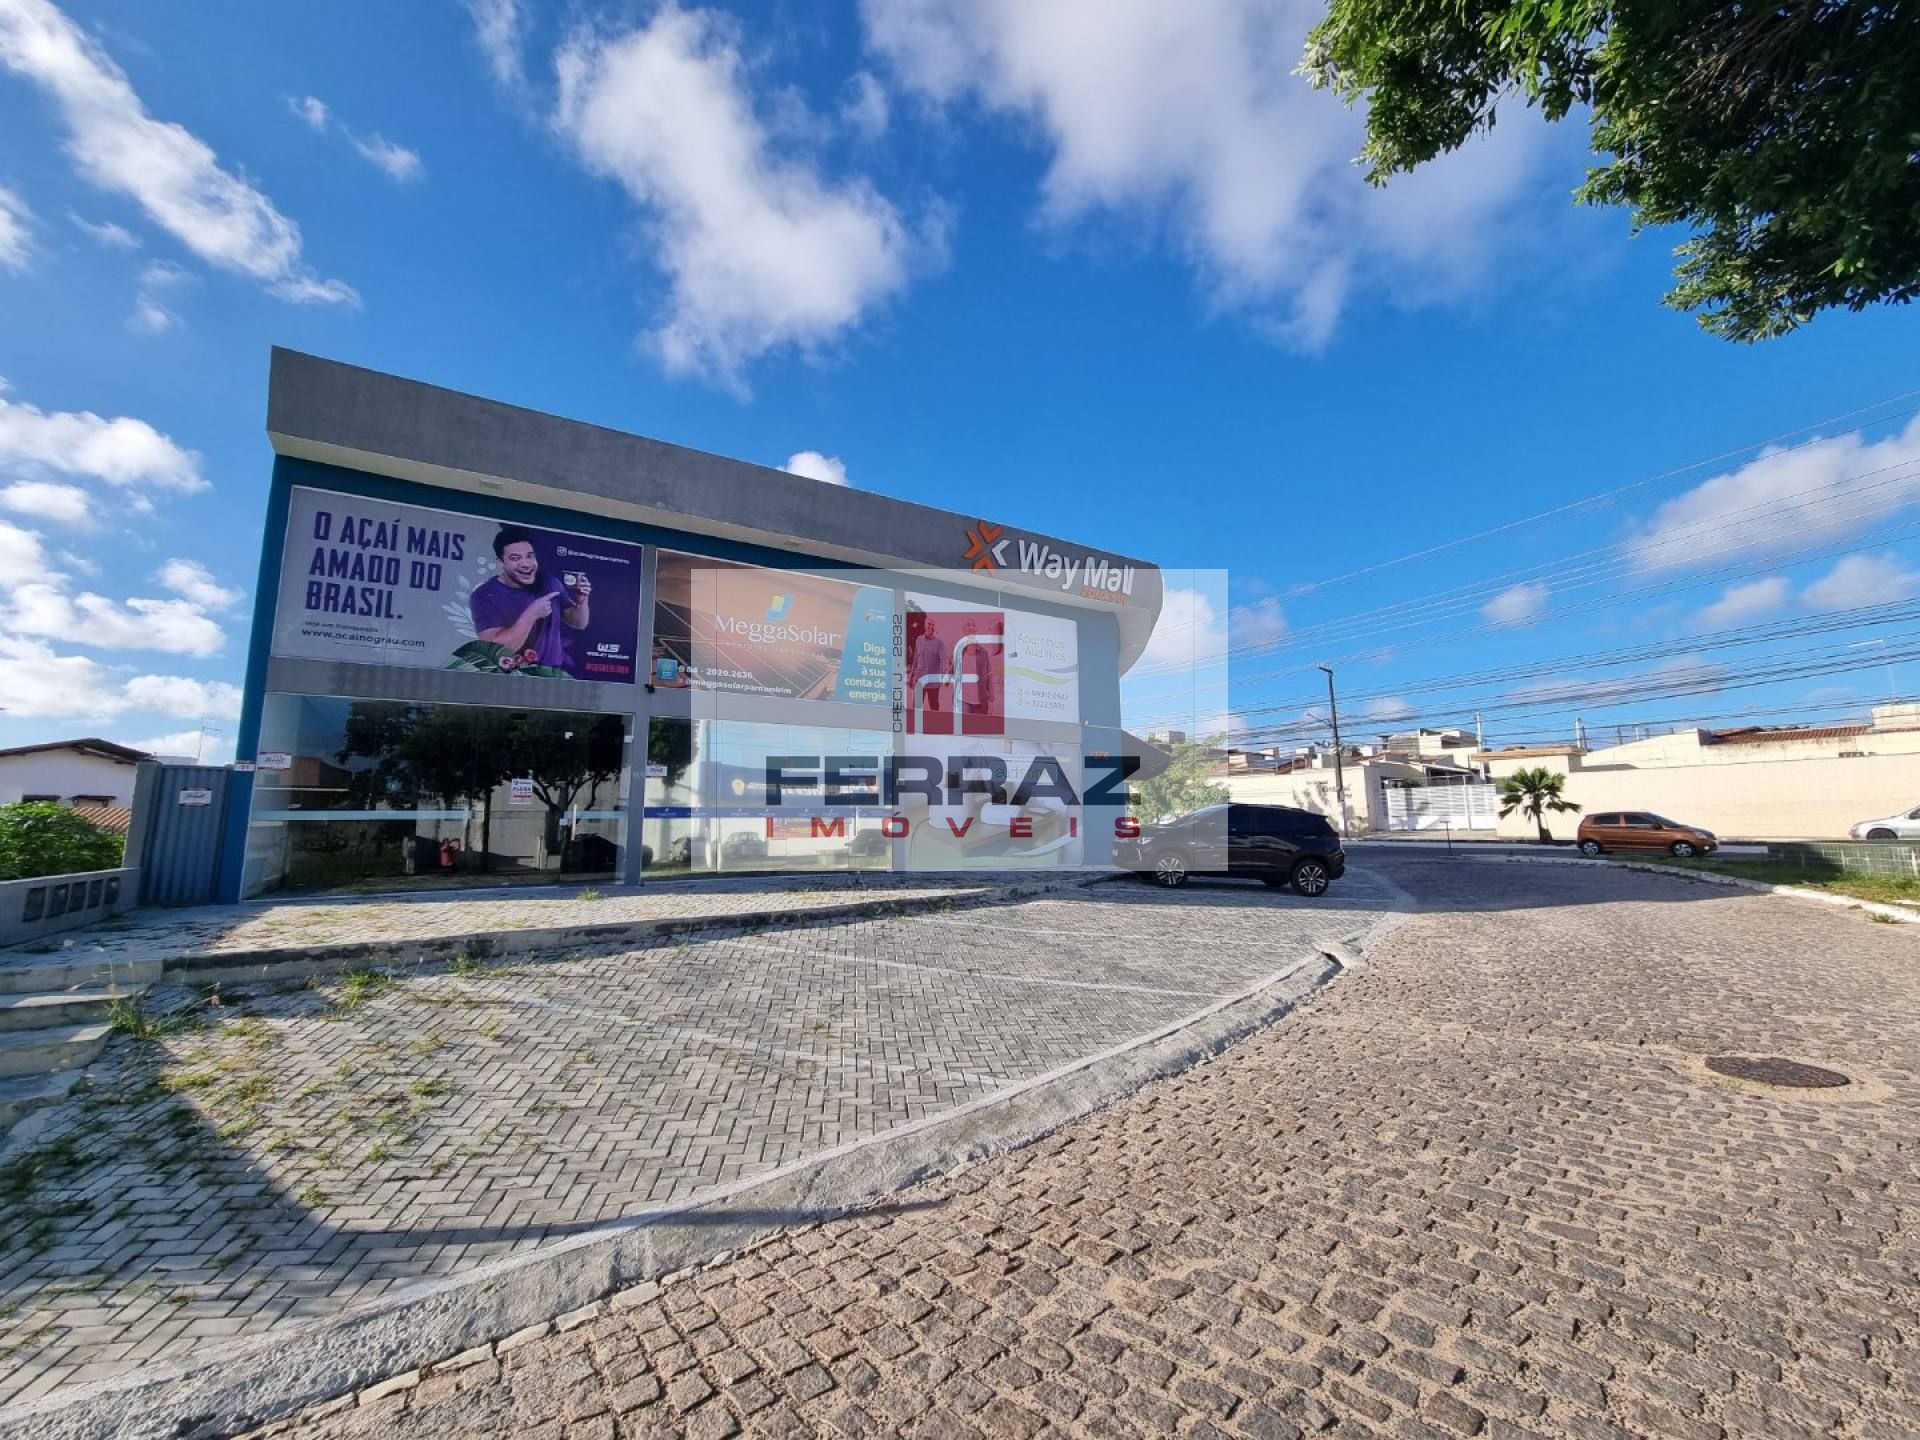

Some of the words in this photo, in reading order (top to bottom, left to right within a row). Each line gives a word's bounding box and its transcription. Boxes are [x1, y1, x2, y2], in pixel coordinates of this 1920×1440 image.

[314, 511, 332, 541] O
[339, 516, 401, 550] AÇAÍ
[407, 526, 466, 561] MAIS
[309, 547, 401, 586] AMADO
[409, 560, 442, 591] DO
[1018, 539, 1081, 590] Way
[1084, 556, 1134, 596] Mall
[305, 580, 403, 619] BRASIL.
[714, 614, 837, 647] MeggaSolar
[856, 655, 886, 666] adeus
[863, 642, 886, 656] Diga
[844, 678, 872, 688] conta
[873, 679, 886, 689] de
[868, 667, 886, 677] sua
[848, 689, 887, 702] energia
